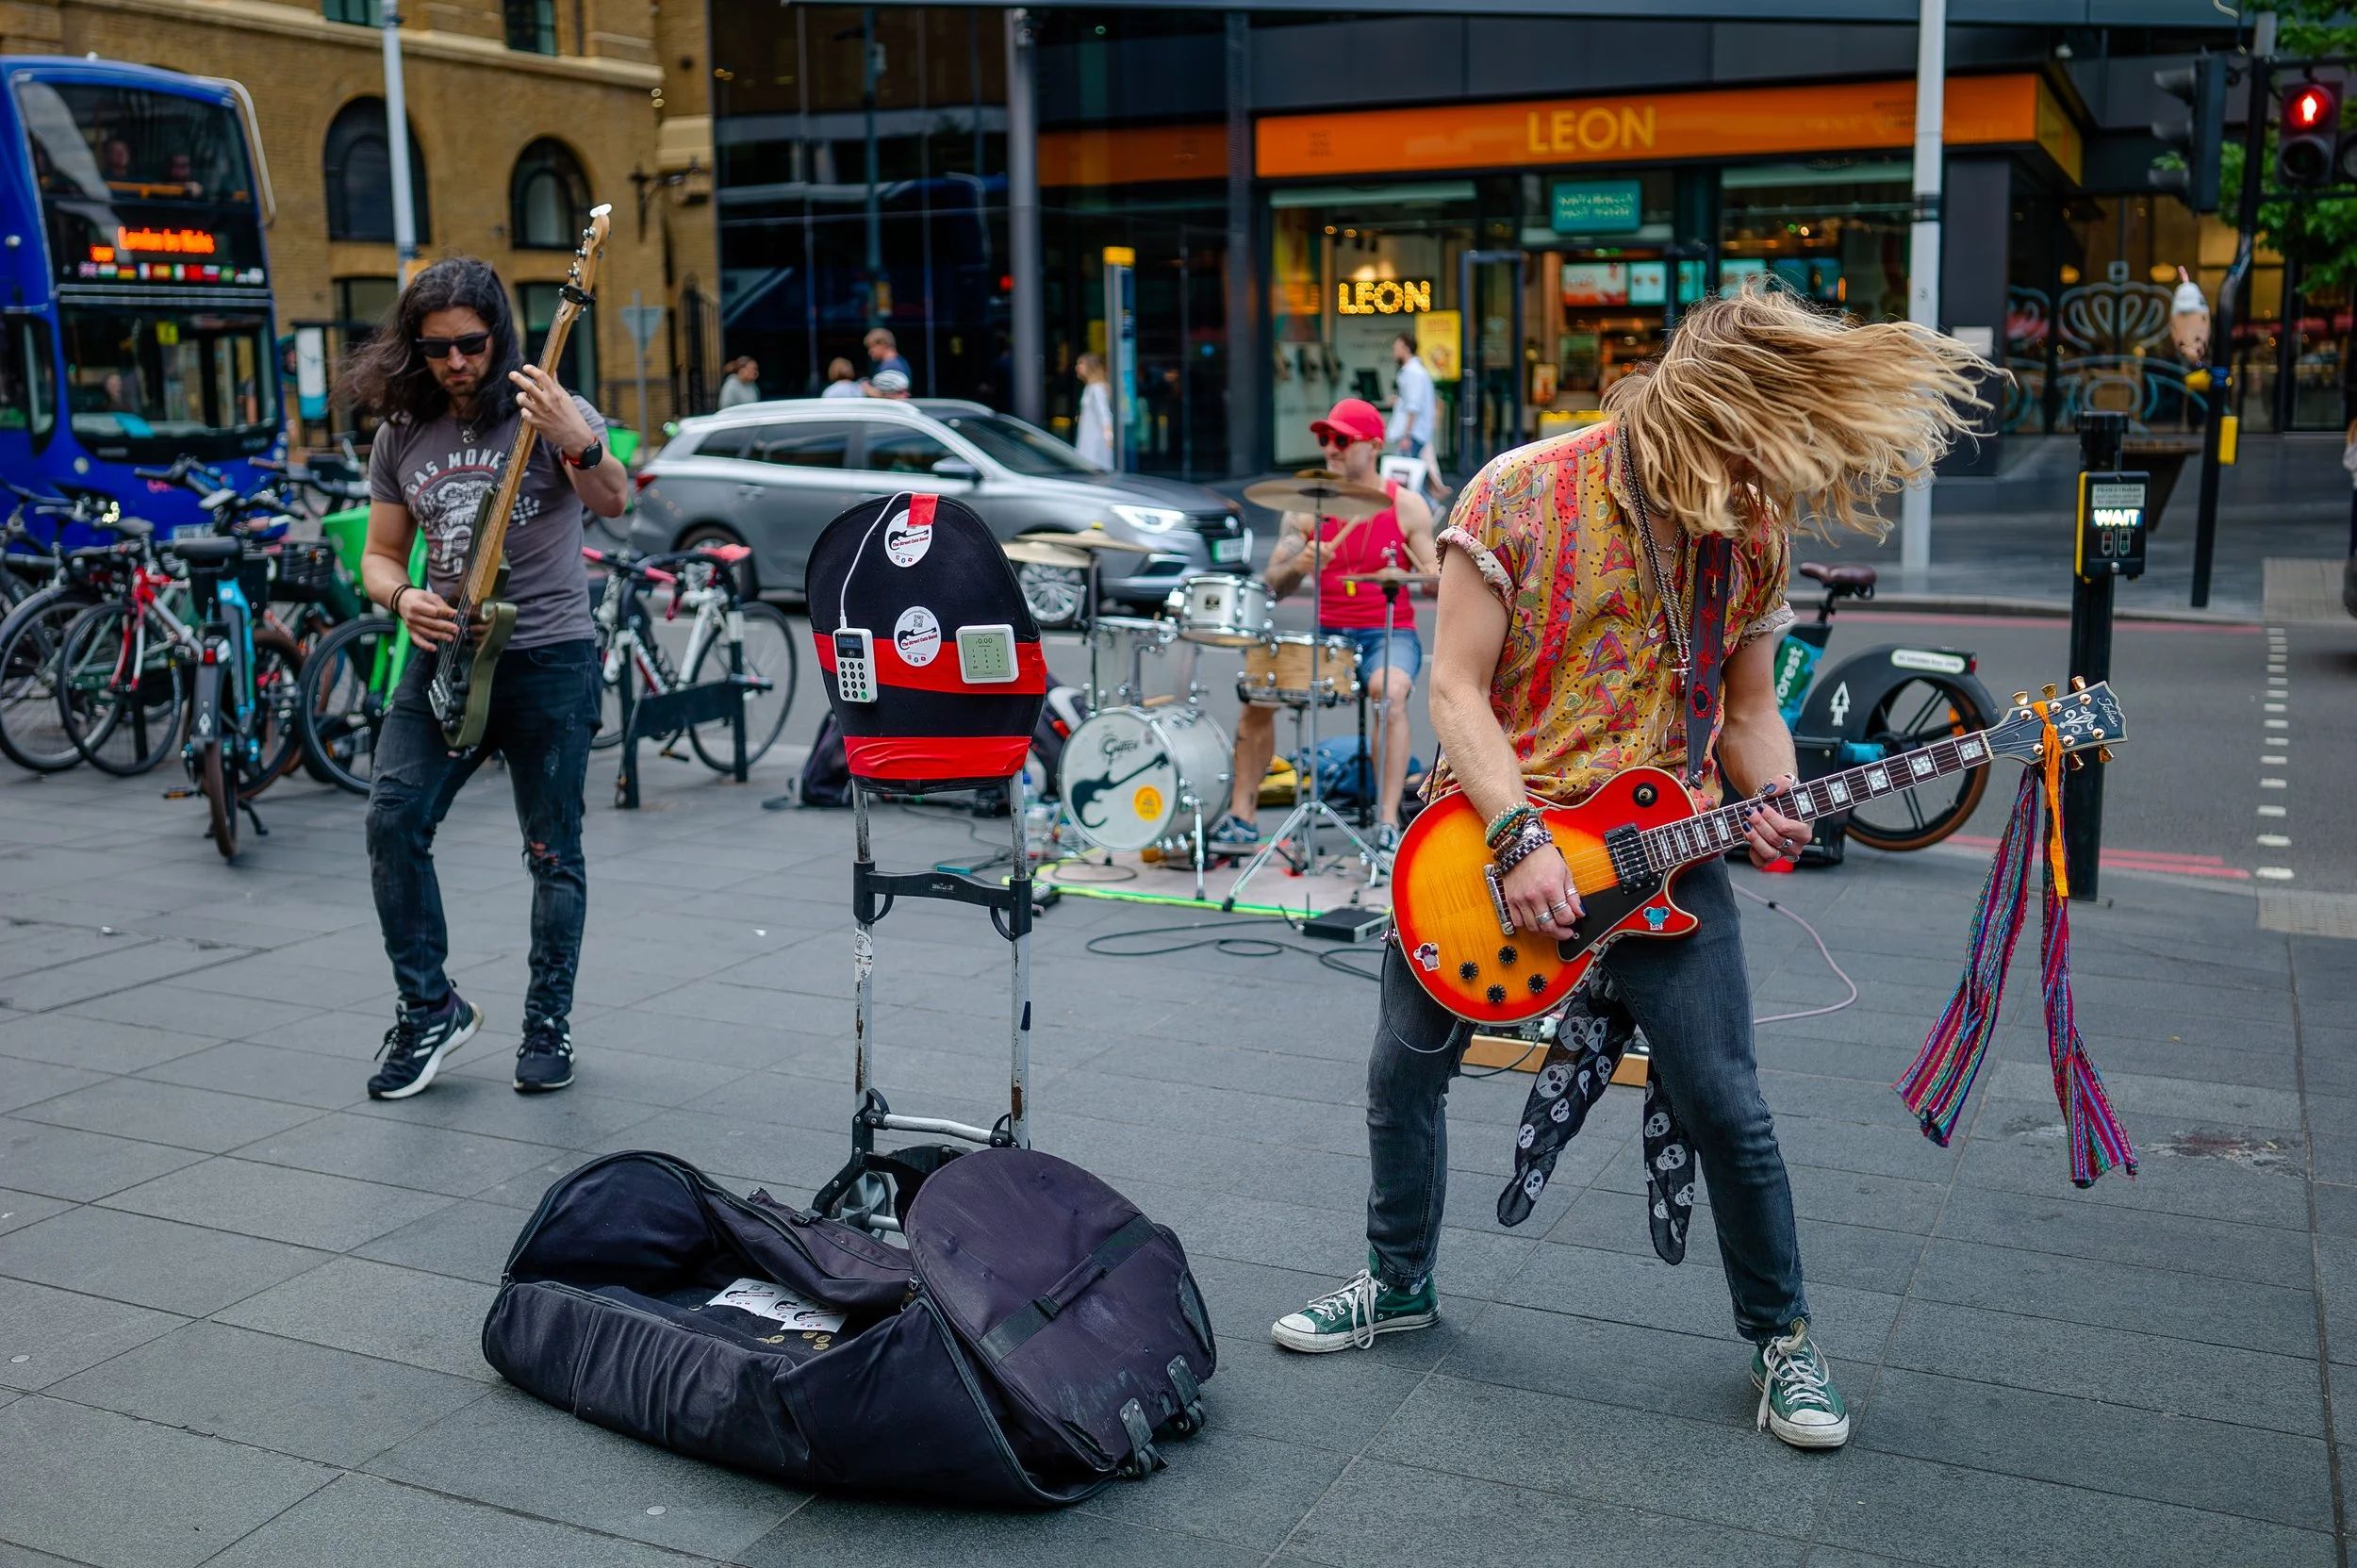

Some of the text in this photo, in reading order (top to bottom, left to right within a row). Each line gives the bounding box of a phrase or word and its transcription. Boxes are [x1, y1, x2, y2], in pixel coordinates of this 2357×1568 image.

[1526, 105, 1656, 155] LEON
[1339, 281, 1430, 314] LEON
[406, 448, 506, 494] GAS MONK
[2094, 509, 2140, 526] WAIT
